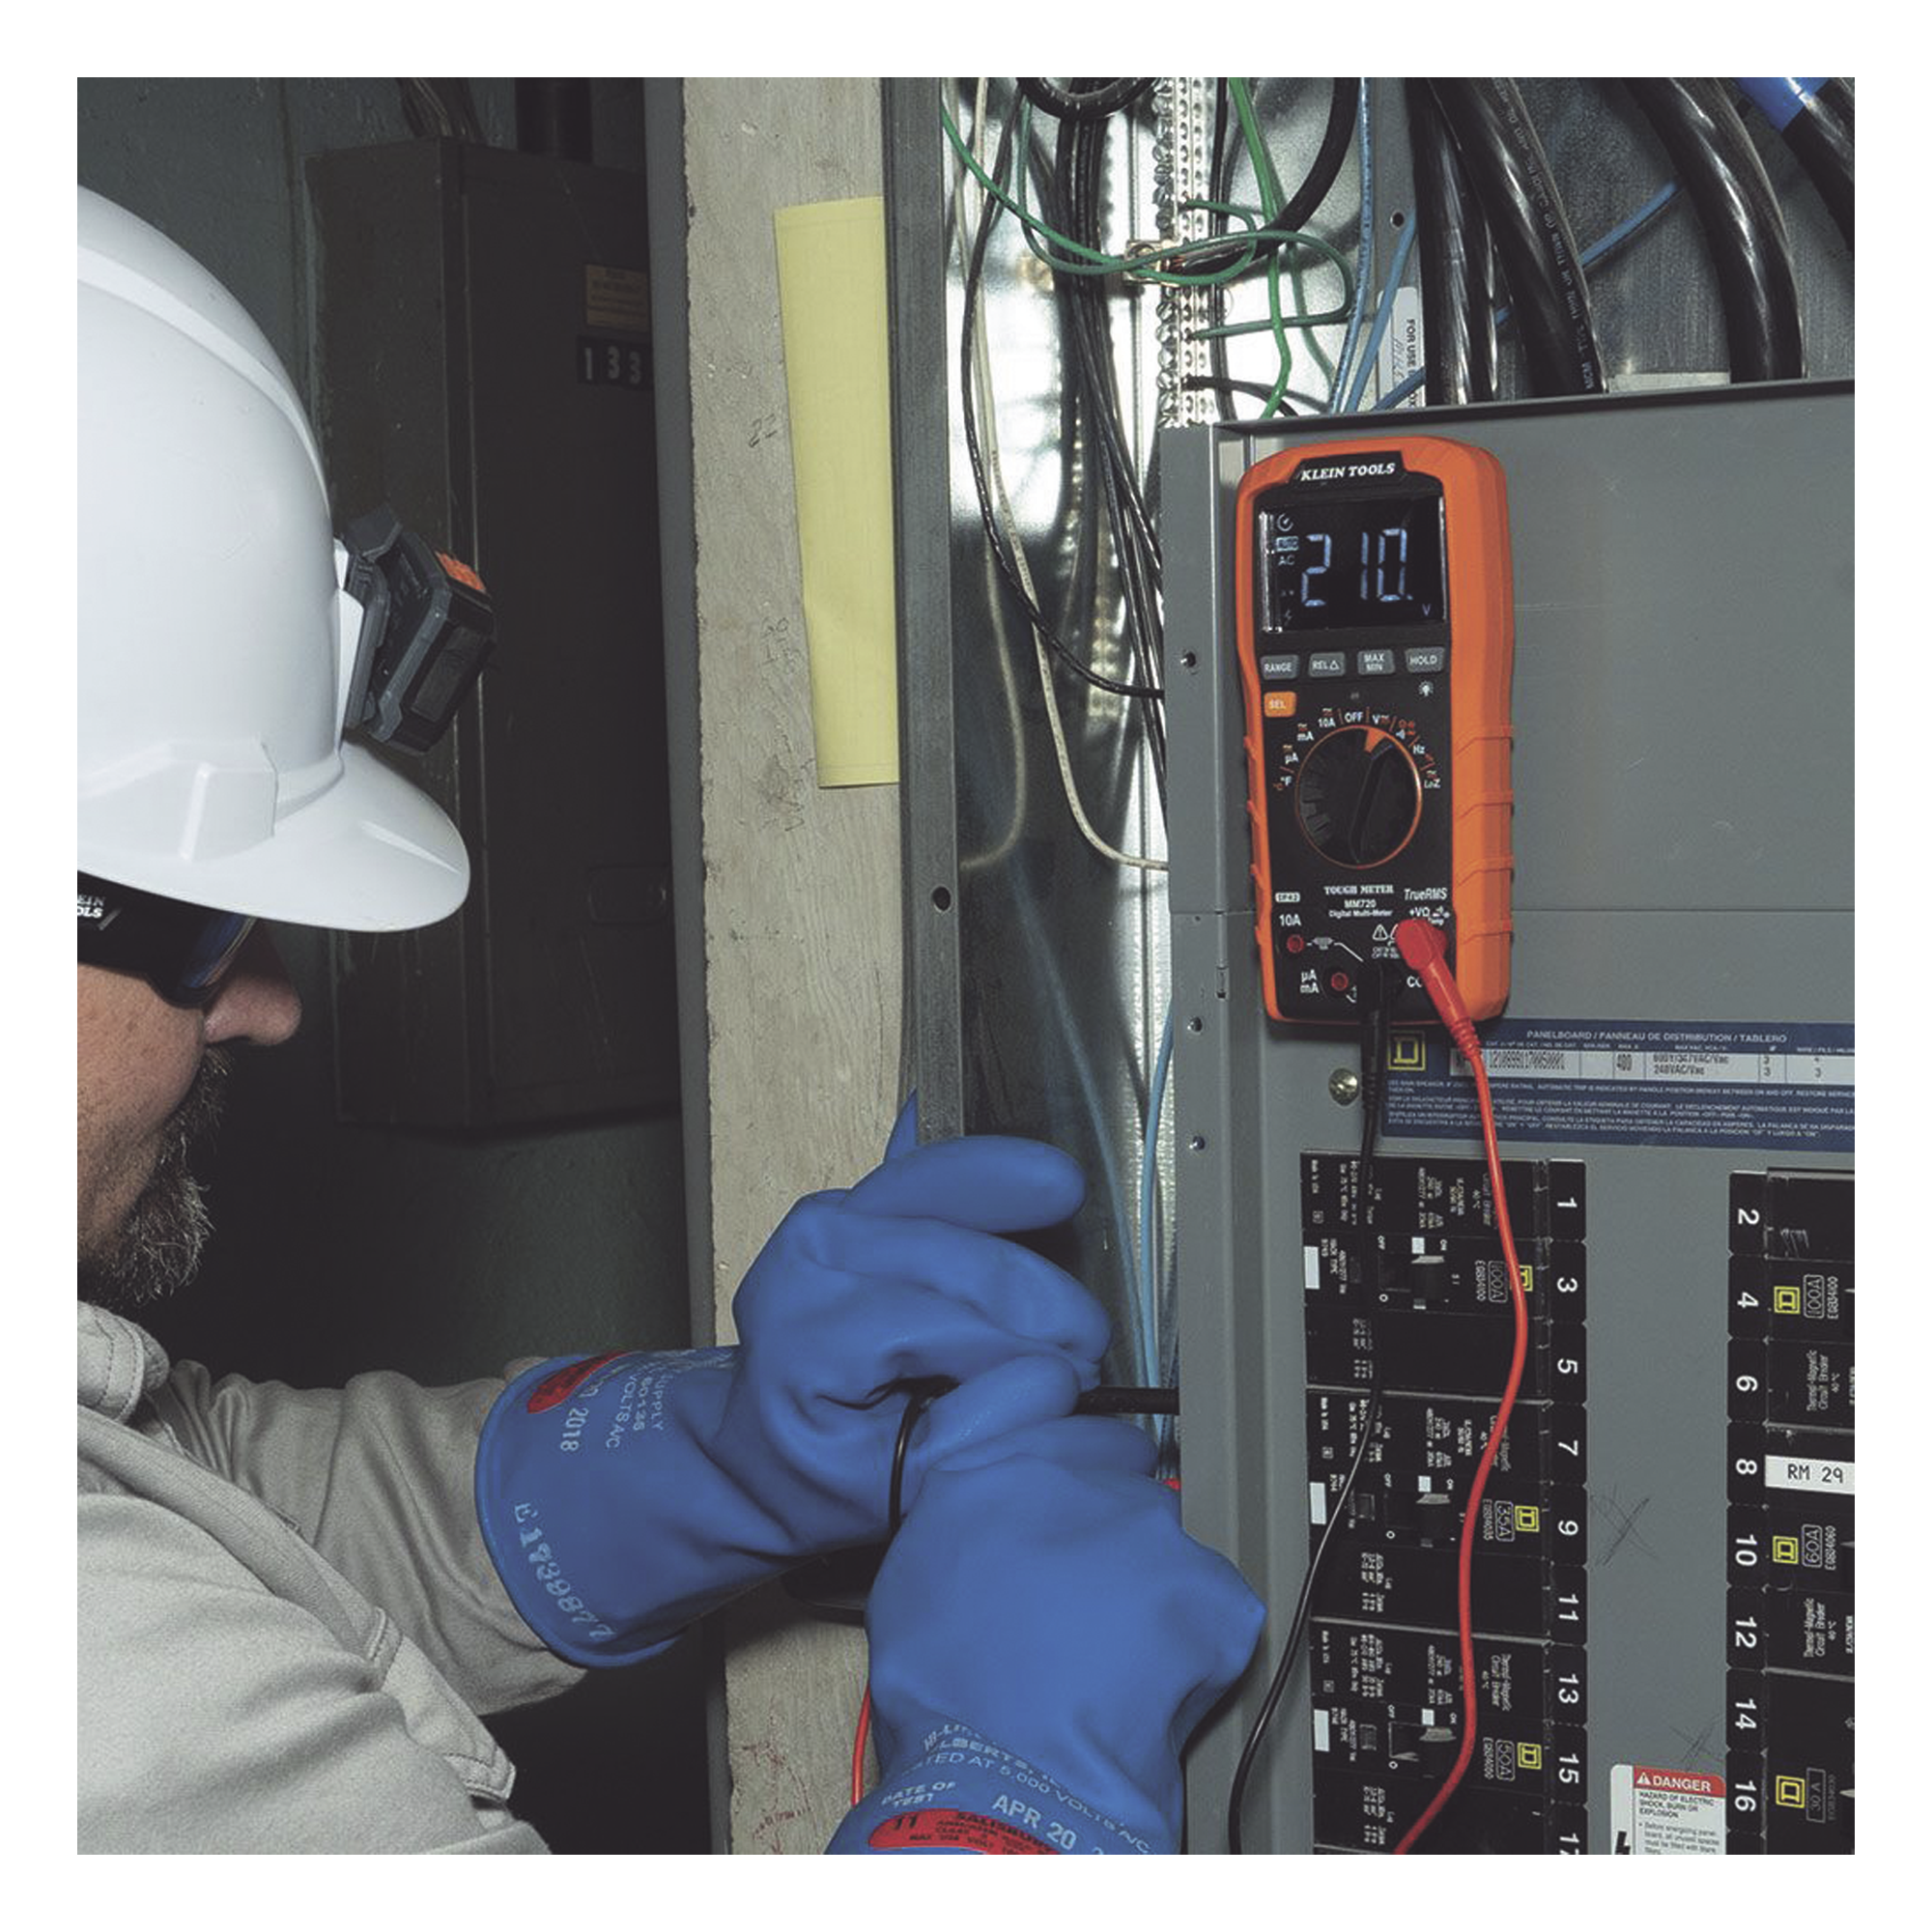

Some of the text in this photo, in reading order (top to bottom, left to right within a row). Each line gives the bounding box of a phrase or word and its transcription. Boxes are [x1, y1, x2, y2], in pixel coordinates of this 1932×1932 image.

[1406, 318, 1416, 366] FOR USE
[1300, 463, 1396, 481] KLEIN TOOLS
[1277, 554, 1295, 566] AC
[1312, 661, 1328, 670] REL
[1363, 653, 1384, 663] MAX
[1409, 655, 1437, 666] HOLD
[1264, 662, 1292, 672] RANGE
[1268, 699, 1287, 709] SEL
[1318, 717, 1336, 728] 10A
[1344, 712, 1363, 724] OFF
[1323, 885, 1394, 896] TOUGH METER
[1404, 888, 1448, 901] TrueRMS
[1344, 898, 1377, 909] MM720
[1279, 915, 1302, 926] 10A
[1526, 1030, 1592, 1040] PANELBOARD
[1599, 1032, 1645, 1041] PANNEAU
[1648, 1033, 1661, 1041] DE
[1663, 1033, 1732, 1042] DISTRIBUTION
[1739, 1034, 1788, 1043] TABLERO
[1556, 1197, 1577, 1208] 1
[1738, 1208, 1760, 1225] 2
[1377, 1236, 1386, 1251] OFF
[1557, 1277, 1578, 1293] 3
[1737, 1292, 1759, 1309] 4
[1806, 1278, 1822, 1316] 100A
[1557, 1358, 1578, 1374] 5
[1736, 1375, 1758, 1392] 6
[615, 1374, 638, 1422] VOLTS
[560, 1407, 590, 1452] 2018
[1558, 1440, 1578, 1456] 7
[1735, 1459, 1758, 1475] 8
[1787, 1463, 1843, 1484] RM 29
[1383, 1472, 1392, 1488] OFF
[1497, 1504, 1511, 1537] 35A
[1558, 1520, 1578, 1536] 9
[1735, 1534, 1757, 1567] 10
[1805, 1529, 1819, 1563] 60A
[1558, 1594, 1578, 1622] 11
[1735, 1616, 1757, 1649] 12
[1558, 1673, 1579, 1704] 13
[1387, 1705, 1396, 1719] OFF
[1735, 1698, 1757, 1730] 14
[1497, 1744, 1512, 1776] 50A
[1558, 1753, 1579, 1784] 15
[1652, 1776, 1712, 1793] DANGER
[967, 1756, 993, 1769] AT
[1054, 1790, 1116, 1831] VOLTS
[1639, 1792, 1668, 1801] HAZARD
[1734, 1779, 1757, 1812] 16
[992, 1794, 1076, 1850] APR 20
